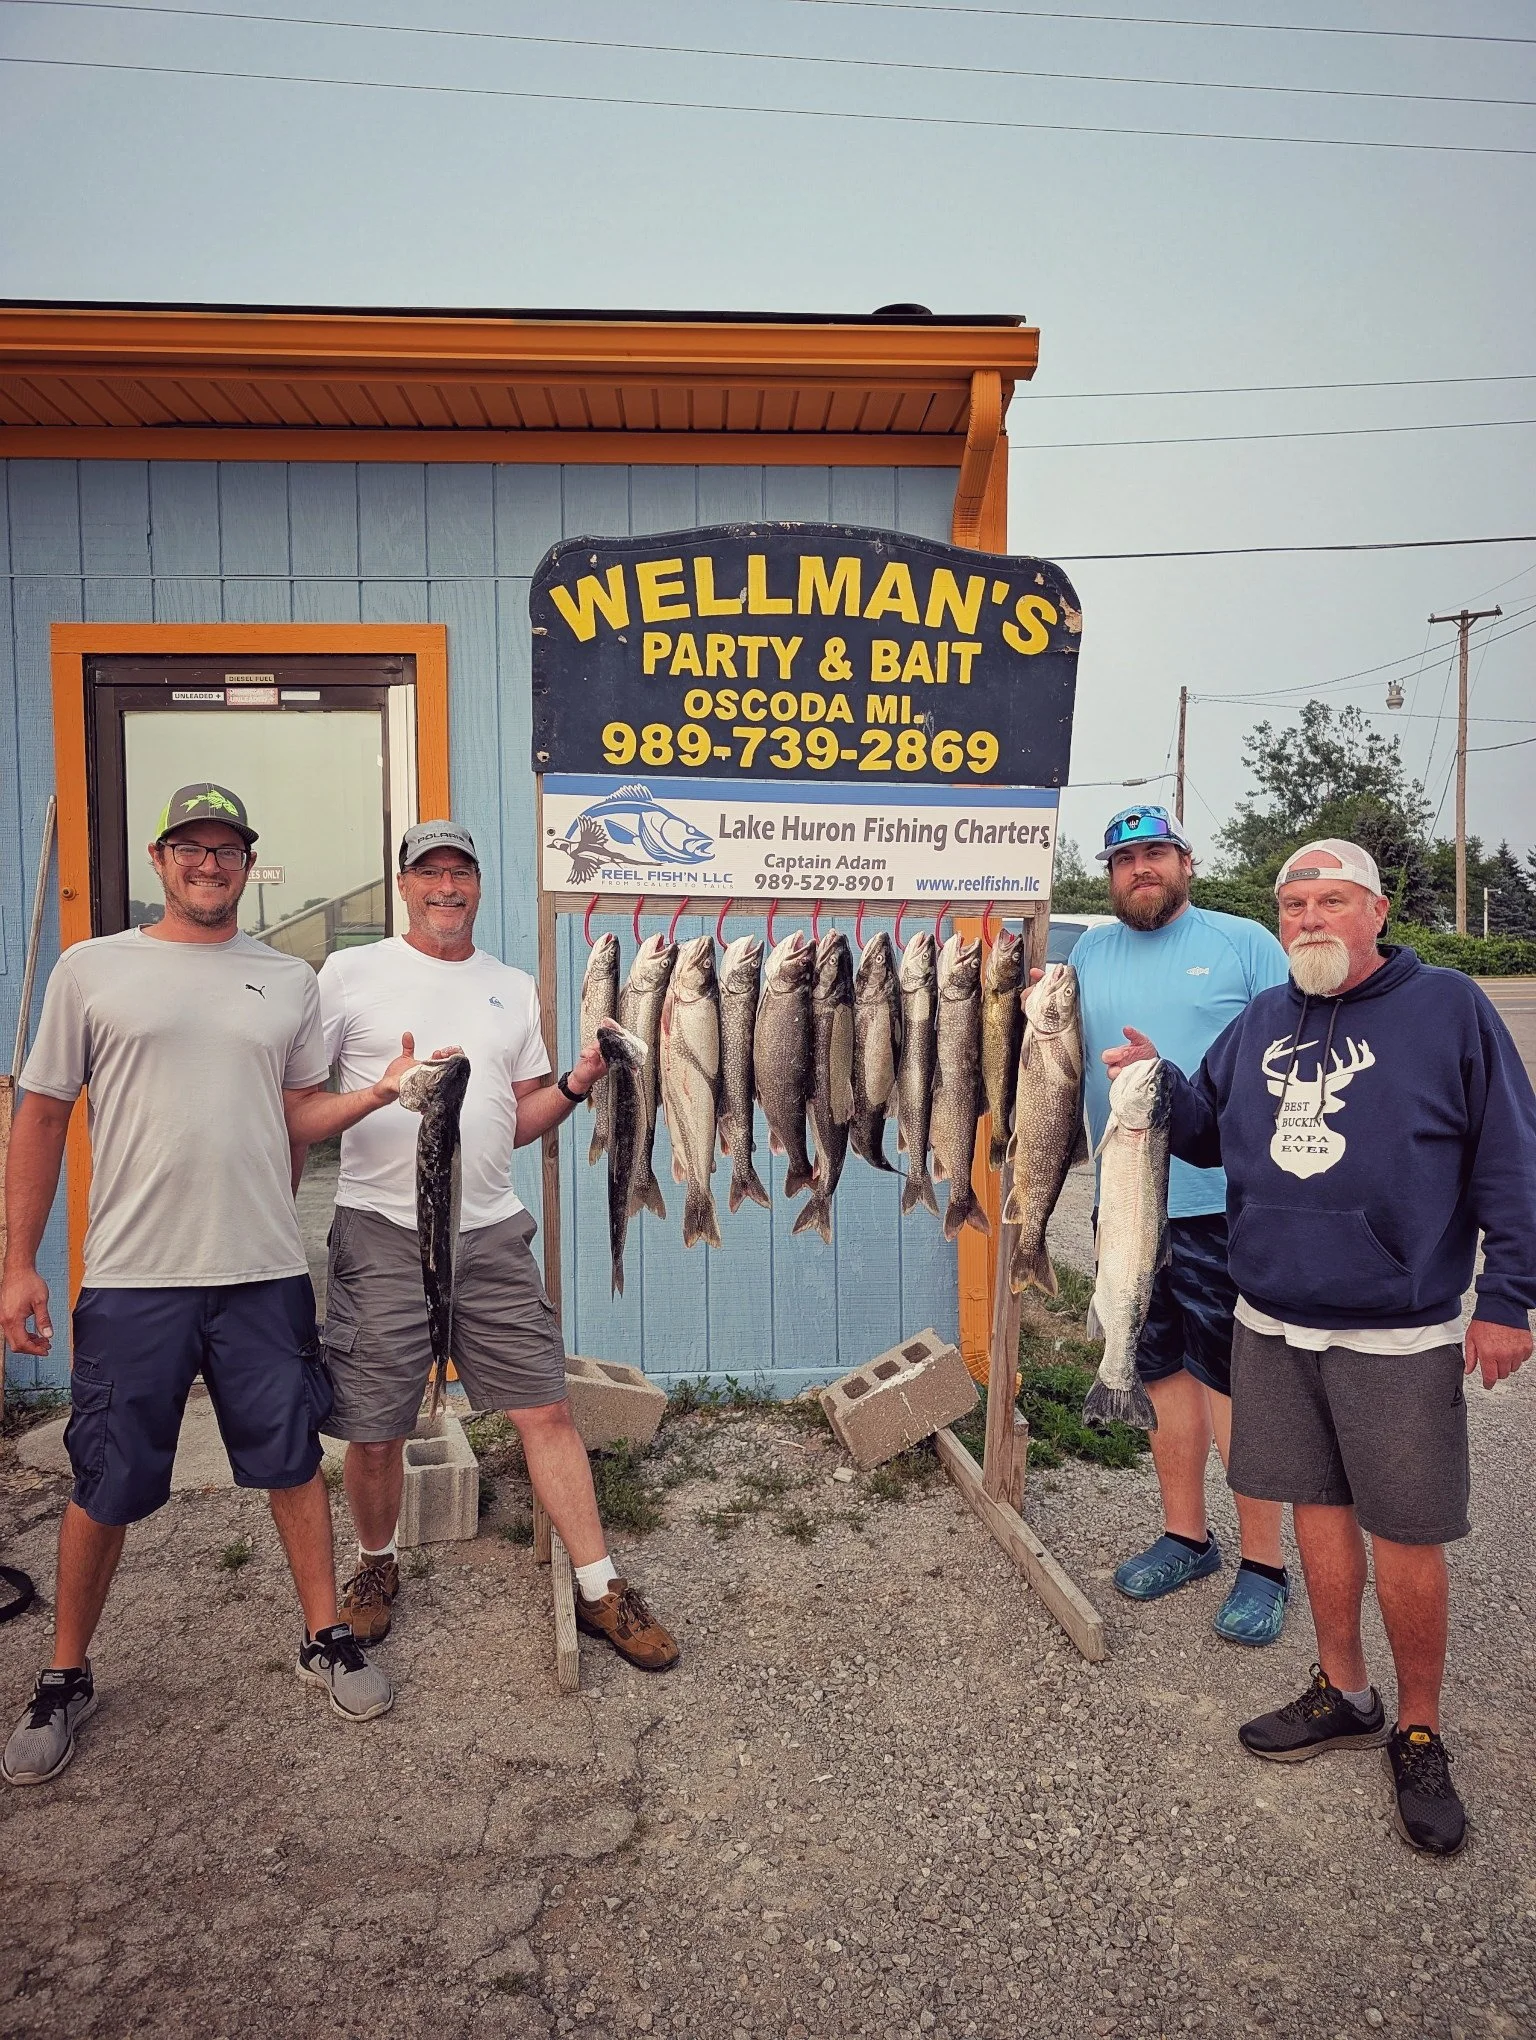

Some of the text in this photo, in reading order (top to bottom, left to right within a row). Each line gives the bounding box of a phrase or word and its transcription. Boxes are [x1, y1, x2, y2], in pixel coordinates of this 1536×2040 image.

[549, 554, 1058, 656] WELLMAN'S
[643, 631, 983, 684] PARTY & BAIT
[684, 688, 925, 725] OSCODA MI.
[602, 721, 999, 774] 989-739-2869
[417, 832, 465, 844] POLARIS
[718, 813, 1050, 851] Lake Huron Fishing Charters
[764, 853, 887, 871] Captain Adam
[262, 870, 280, 879] ONLY
[601, 869, 733, 883] REEL FISH'N LLC
[754, 873, 894, 892] 989-529-8901
[916, 876, 1040, 892] www.reelfishn.llc
[1284, 1102, 1310, 1112] BEST
[1281, 1118, 1322, 1128] BUCKIN
[1282, 1134, 1330, 1143] PAPA
[1280, 1145, 1330, 1154] EVER
